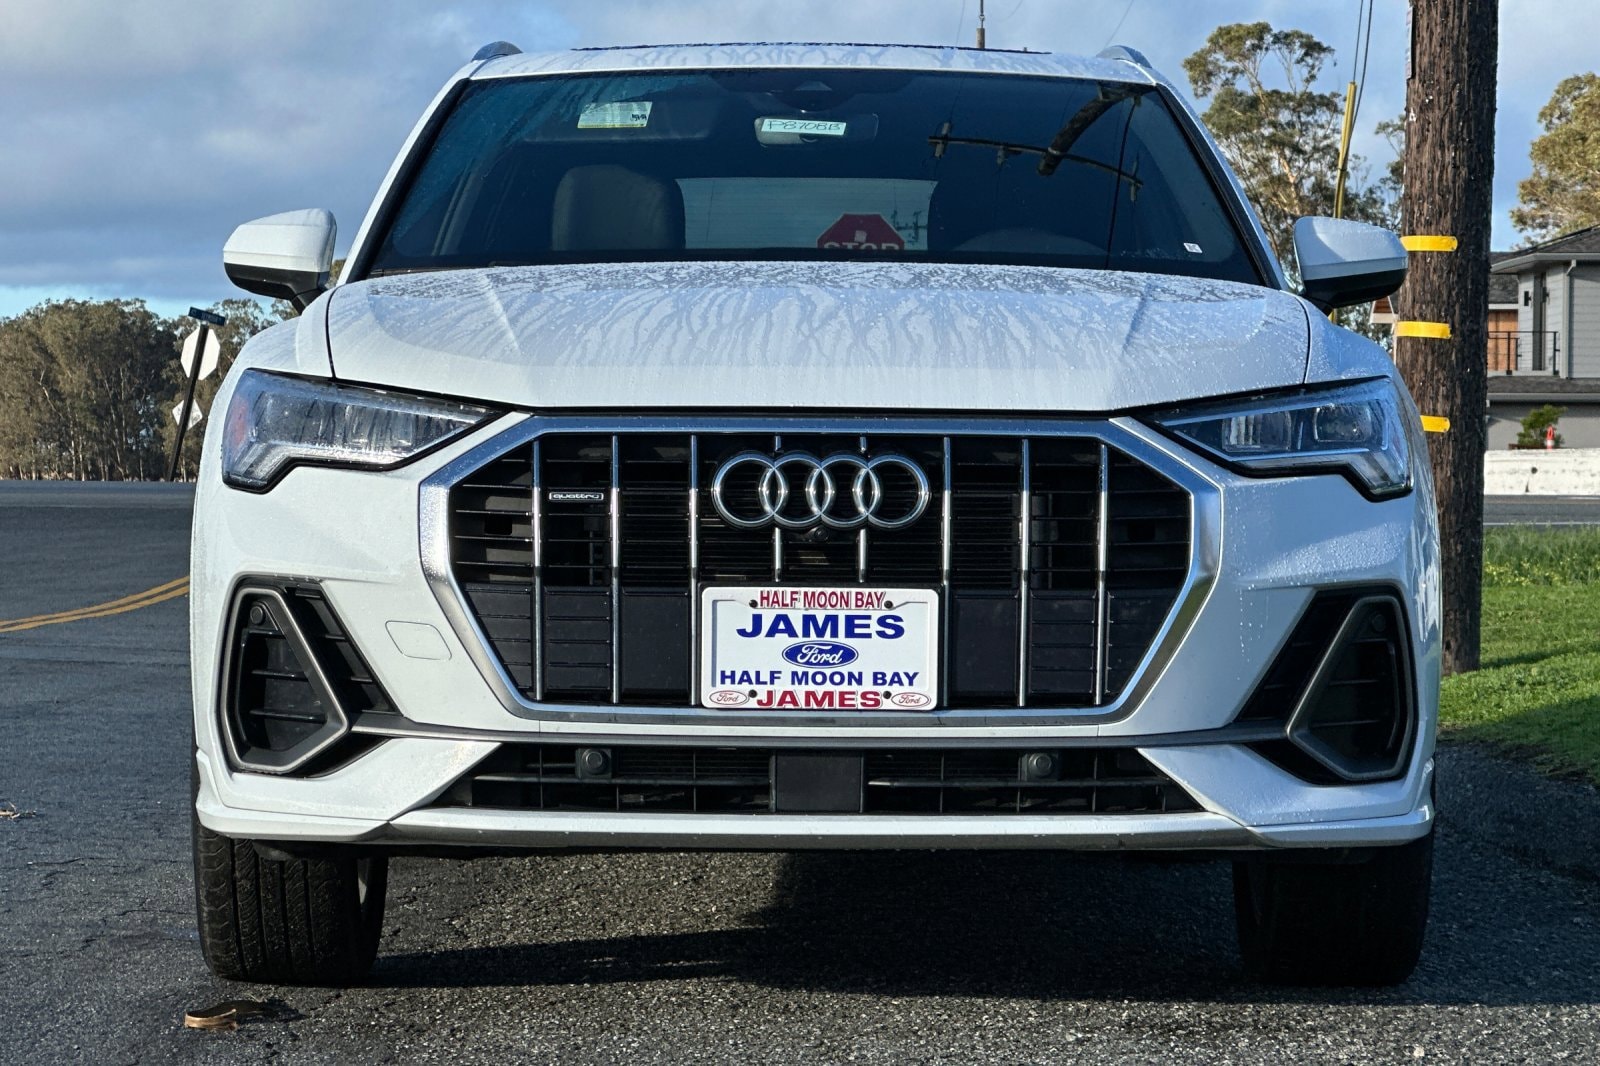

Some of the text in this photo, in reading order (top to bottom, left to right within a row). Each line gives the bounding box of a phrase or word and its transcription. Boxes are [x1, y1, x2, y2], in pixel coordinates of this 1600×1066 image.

[760, 590, 885, 609] HALF MOON BAY
[736, 613, 905, 639] JAMES
[796, 643, 843, 665] Ford
[720, 670, 919, 687] HALF MOON BAY
[716, 692, 740, 703] Ford
[756, 690, 882, 709] JAMES
[899, 694, 922, 705] Ford
